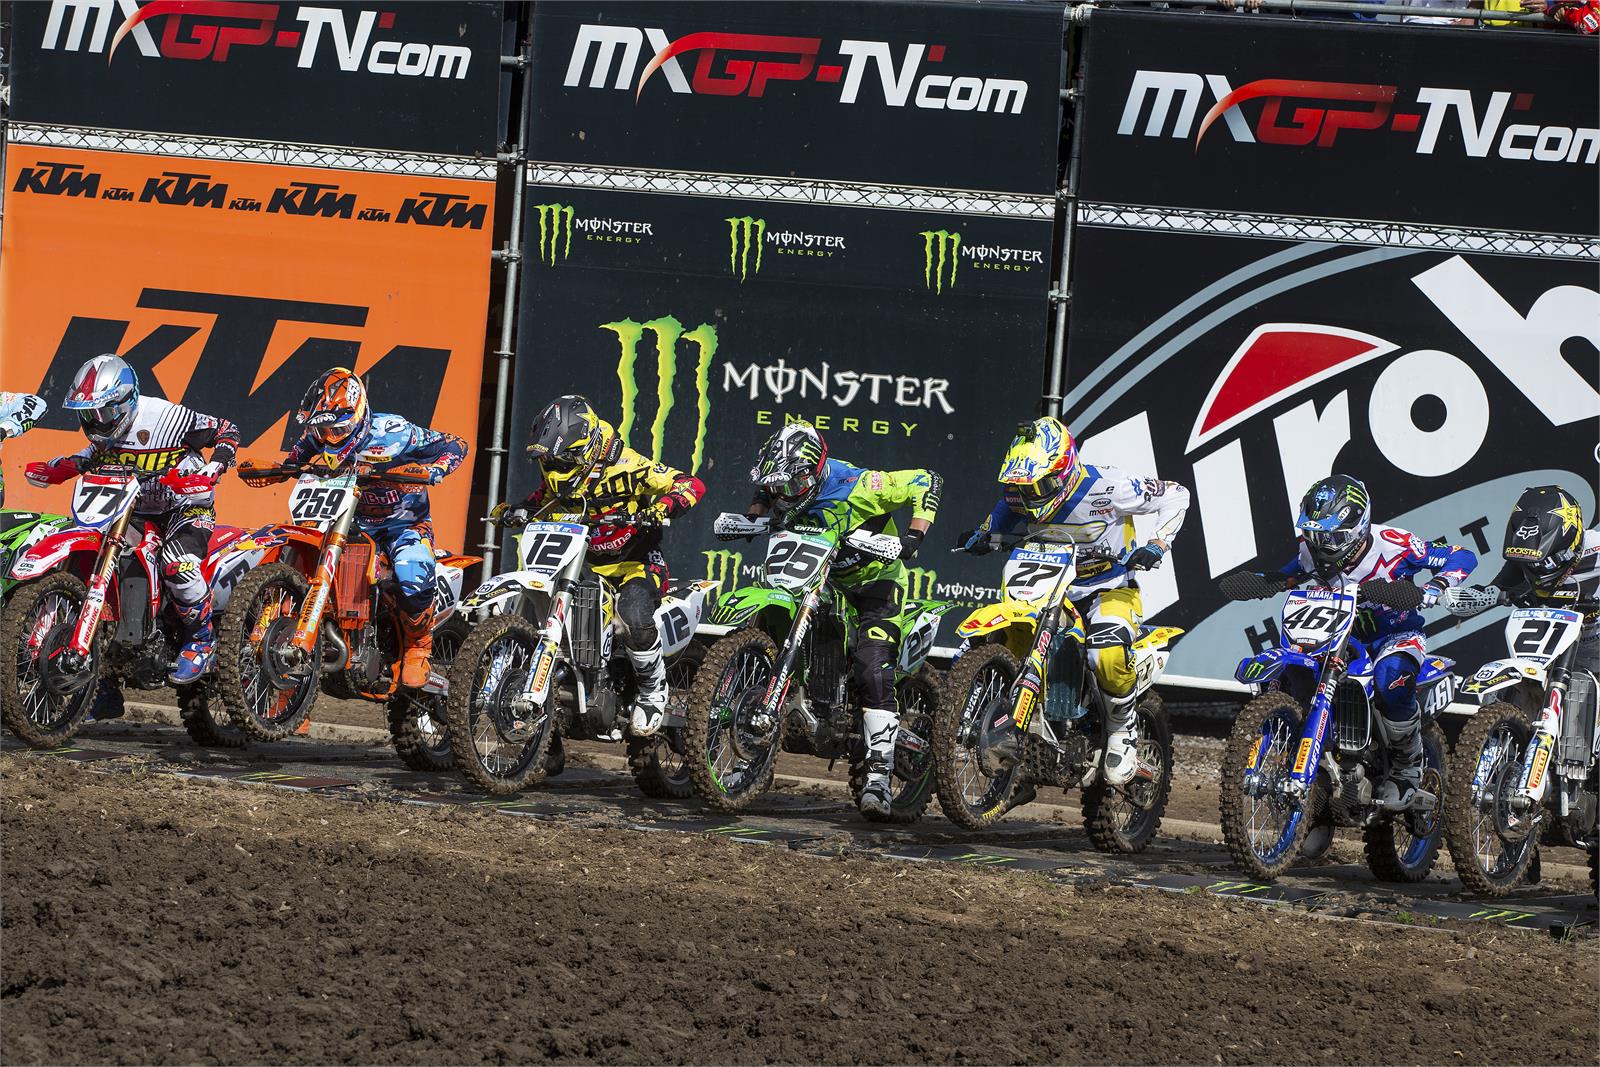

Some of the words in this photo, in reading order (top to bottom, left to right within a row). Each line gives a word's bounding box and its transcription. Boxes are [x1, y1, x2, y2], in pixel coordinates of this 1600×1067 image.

[12, 161, 101, 199] KTM
[101, 188, 134, 202] KTM
[138, 171, 228, 210] KTM
[228, 198, 261, 212] KTM
[265, 181, 358, 220] KTM
[357, 208, 390, 222] KTM
[395, 192, 488, 230] KTM
[575, 217, 654, 237] MONSTER
[586, 234, 642, 244] ENERGY
[765, 230, 846, 250] MONSTER
[777, 247, 834, 257] ENERGY
[961, 244, 1044, 264] MONSTER
[973, 261, 1031, 272] ENERGY
[35, 287, 452, 452] KTM
[722, 358, 955, 414] MONSTER
[757, 410, 918, 437] ENERGY
[77, 485, 129, 516] 77
[292, 488, 347, 519] 259
[525, 533, 573, 567] 12
[765, 540, 828, 580] 25
[1016, 551, 1062, 564] SUZUKI
[1506, 547, 1543, 558] ROCKSTAR
[1005, 562, 1064, 588] 27
[936, 582, 1002, 600] MONST
[1305, 591, 1335, 601] YAMAHA
[661, 606, 691, 647] 12
[1283, 605, 1351, 634] 461
[1513, 619, 1569, 656] 21
[533, 655, 552, 693] PIRELLI
[770, 665, 788, 711] DUNLOP
[1016, 691, 1032, 725] PIRELLI
[1424, 675, 1453, 716] 461
[1295, 739, 1311, 770] PIRELLI
[1532, 751, 1547, 789] PIRELLI
